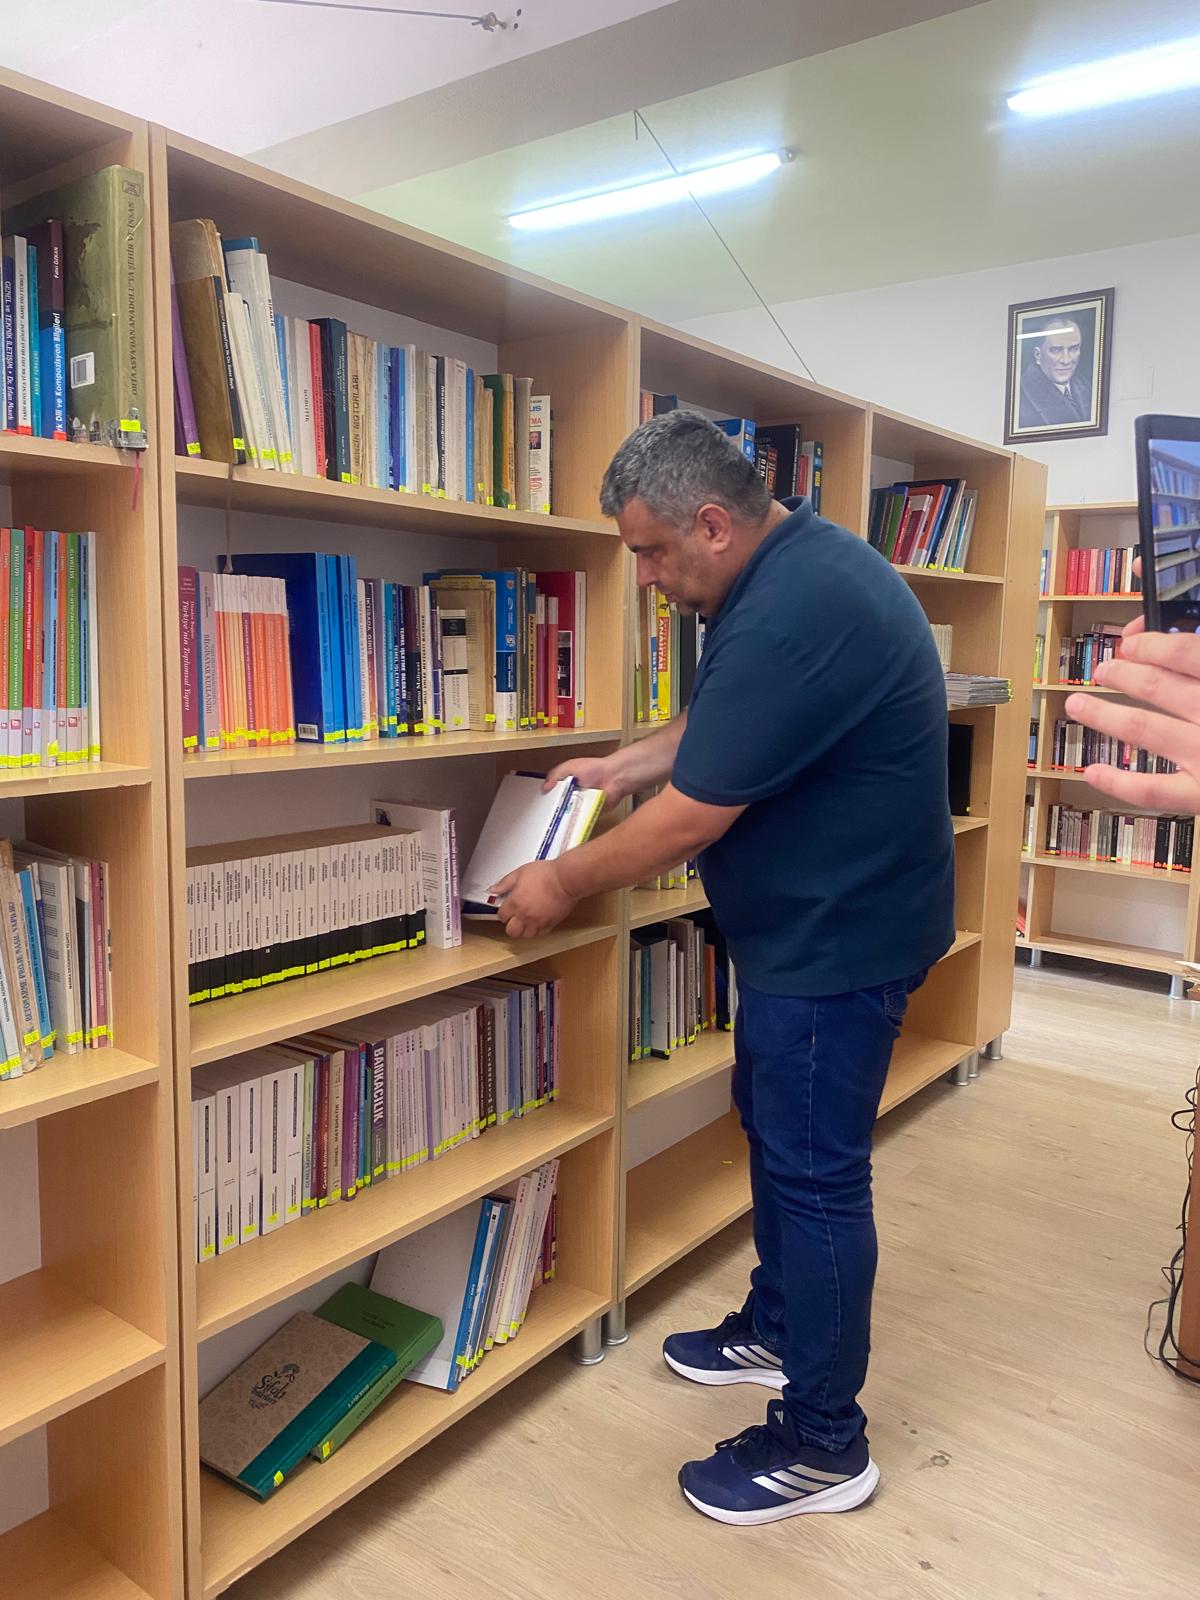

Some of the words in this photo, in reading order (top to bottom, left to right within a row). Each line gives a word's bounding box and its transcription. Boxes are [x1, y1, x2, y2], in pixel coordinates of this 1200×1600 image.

[127, 202, 135, 228] İNSAN
[127, 242, 136, 271] ŞEHİR
[4, 280, 12, 304] GENEL
[127, 272, 137, 329] ANADOLU'YA
[128, 330, 137, 370] ASYA'DAN
[54, 343, 63, 396] Kompozisyon
[130, 371, 138, 396] ORTA
[352, 374, 360, 430] MOTORLARI
[182, 600, 190, 645] Türkiye'nin
[183, 647, 192, 686] Toplumsal
[184, 688, 192, 711] Yapısı
[13, 935, 22, 953] NASIL
[15, 955, 26, 978] PROJE
[373, 1047, 384, 1123] BANKACILIK
